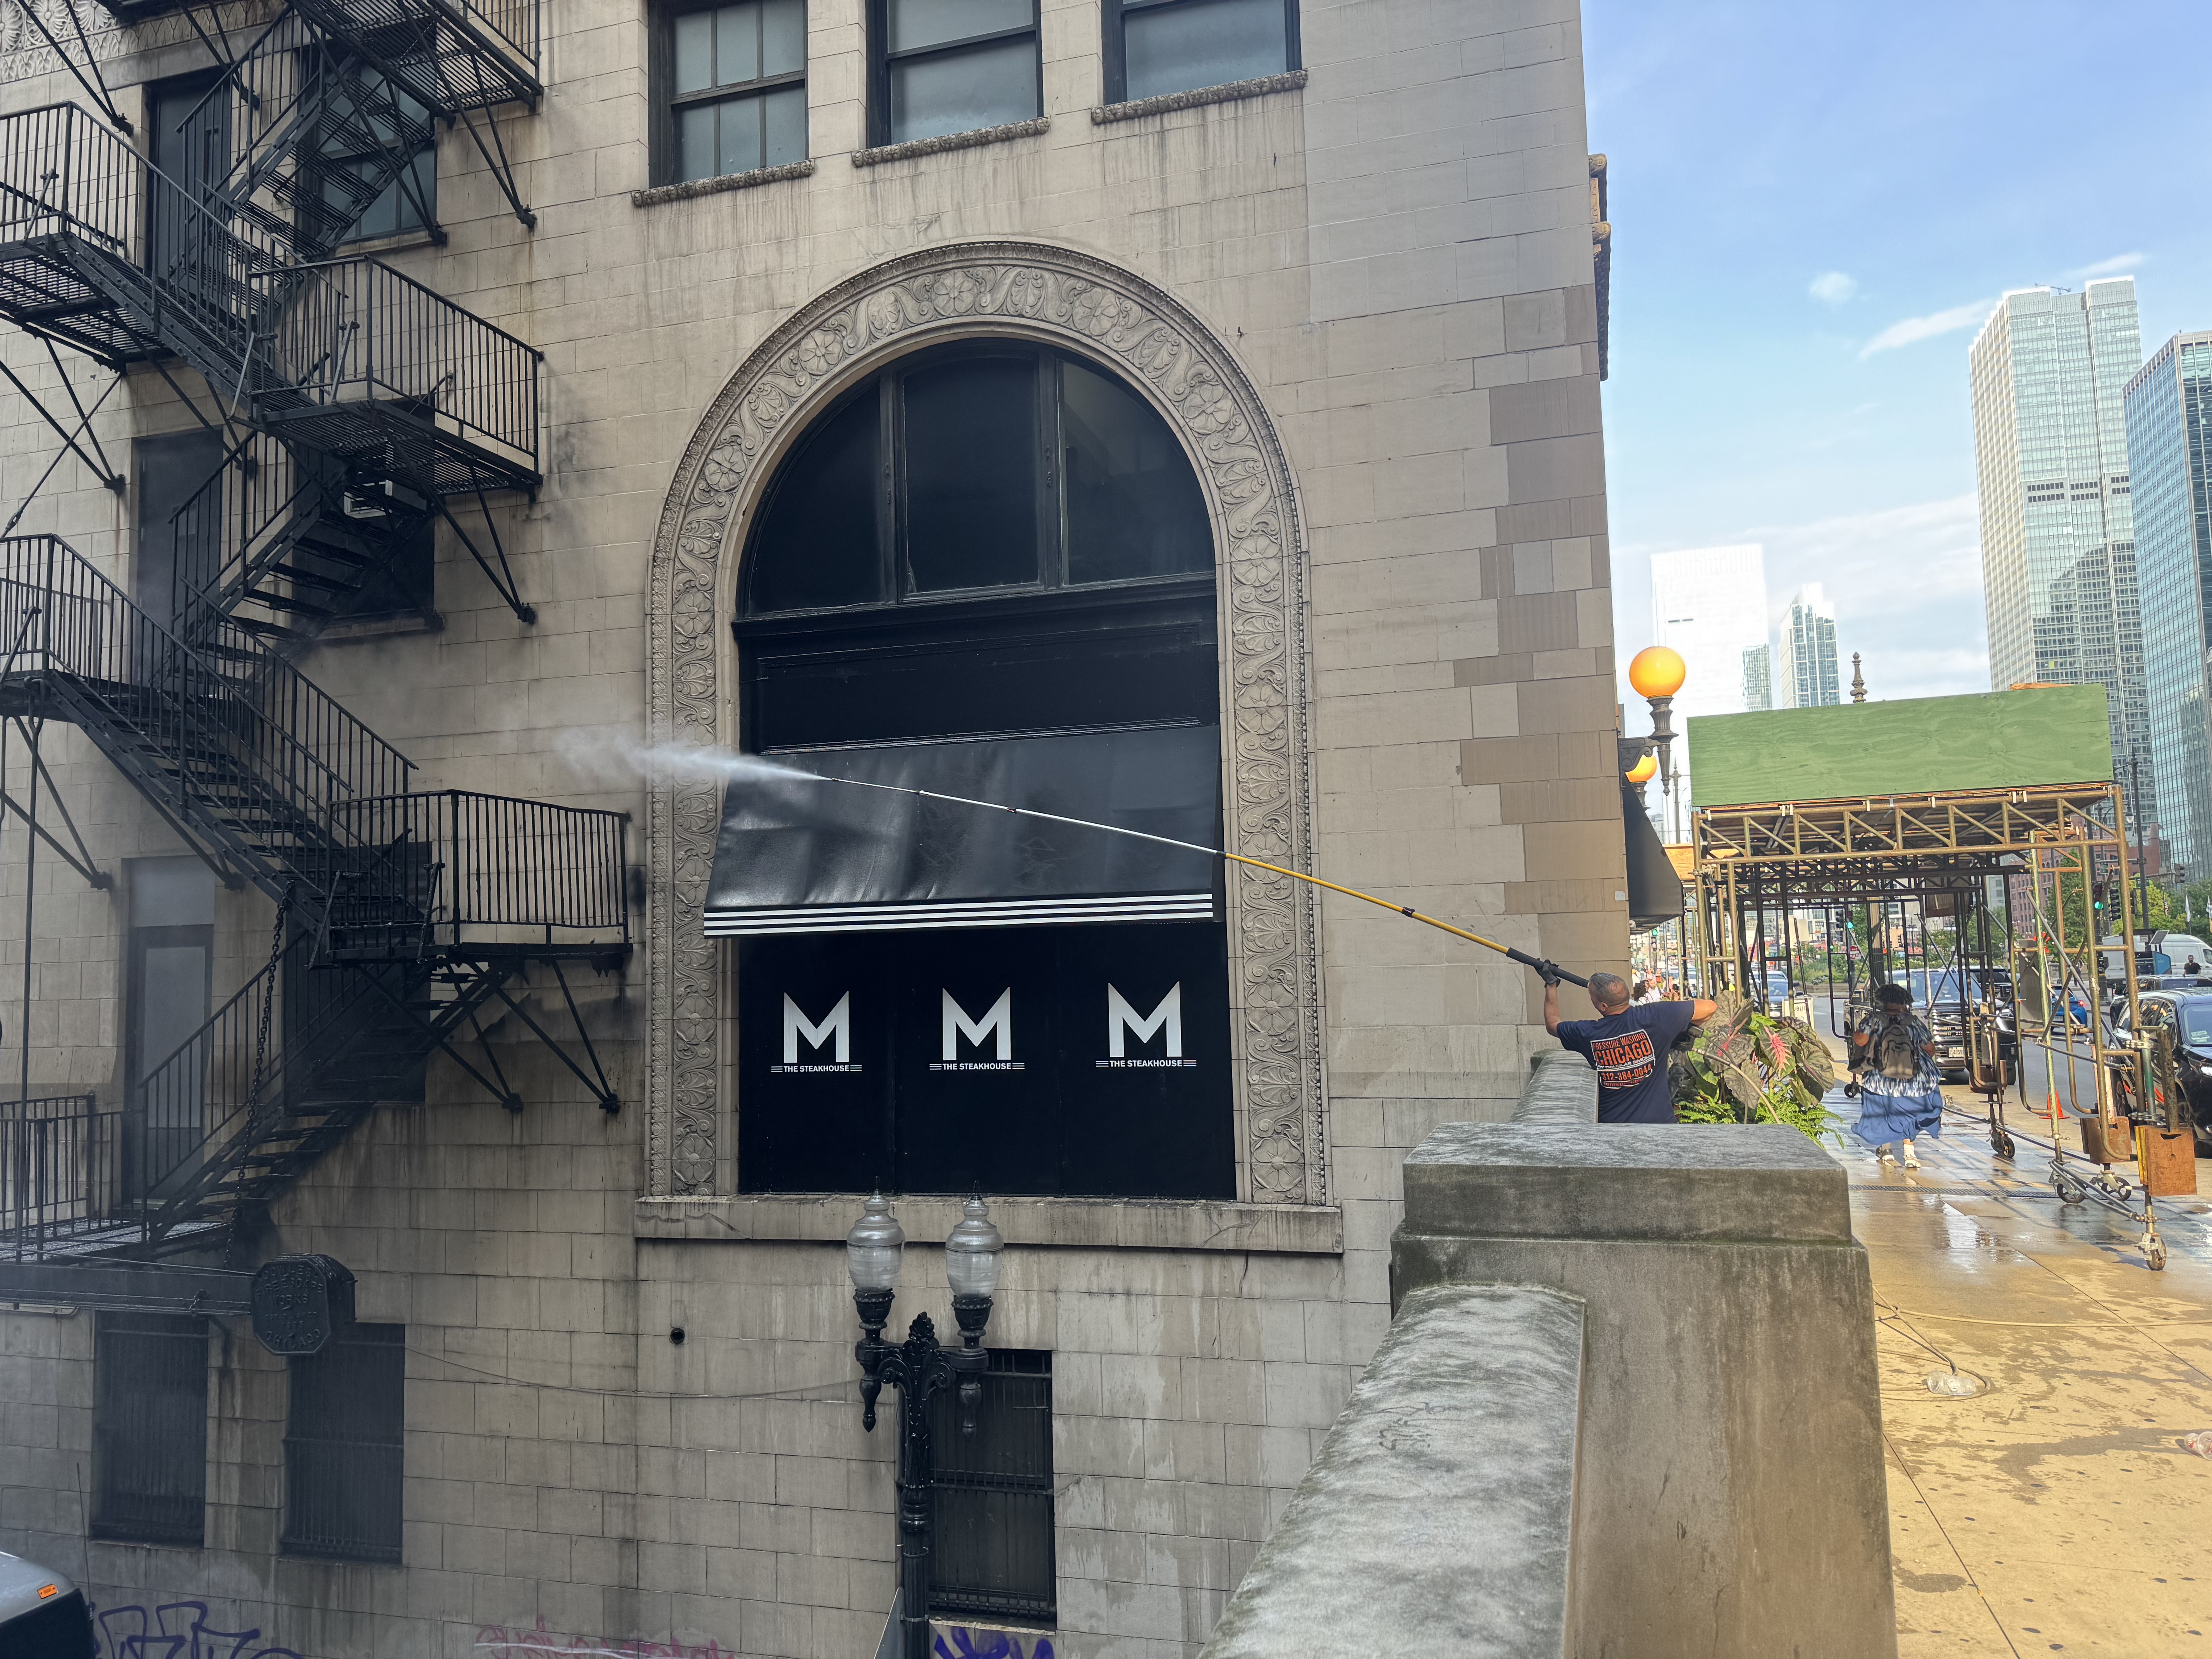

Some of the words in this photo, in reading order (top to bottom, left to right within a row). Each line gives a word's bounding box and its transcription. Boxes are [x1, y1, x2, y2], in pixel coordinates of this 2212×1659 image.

[784, 991, 849, 1063] M
[942, 986, 1011, 1061] M
[1108, 981, 1182, 1058] M
[1592, 1039, 1620, 1051] PRESSURE
[1620, 1032, 1646, 1046] WASHING
[1594, 1040, 1652, 1066] CHICAGO
[1601, 1063, 1652, 1081] 312-384-0044
[281, 1278, 324, 1293] ESCAPE
[270, 1293, 308, 1304] WORKS
[266, 1328, 321, 1348] CHICAGO
